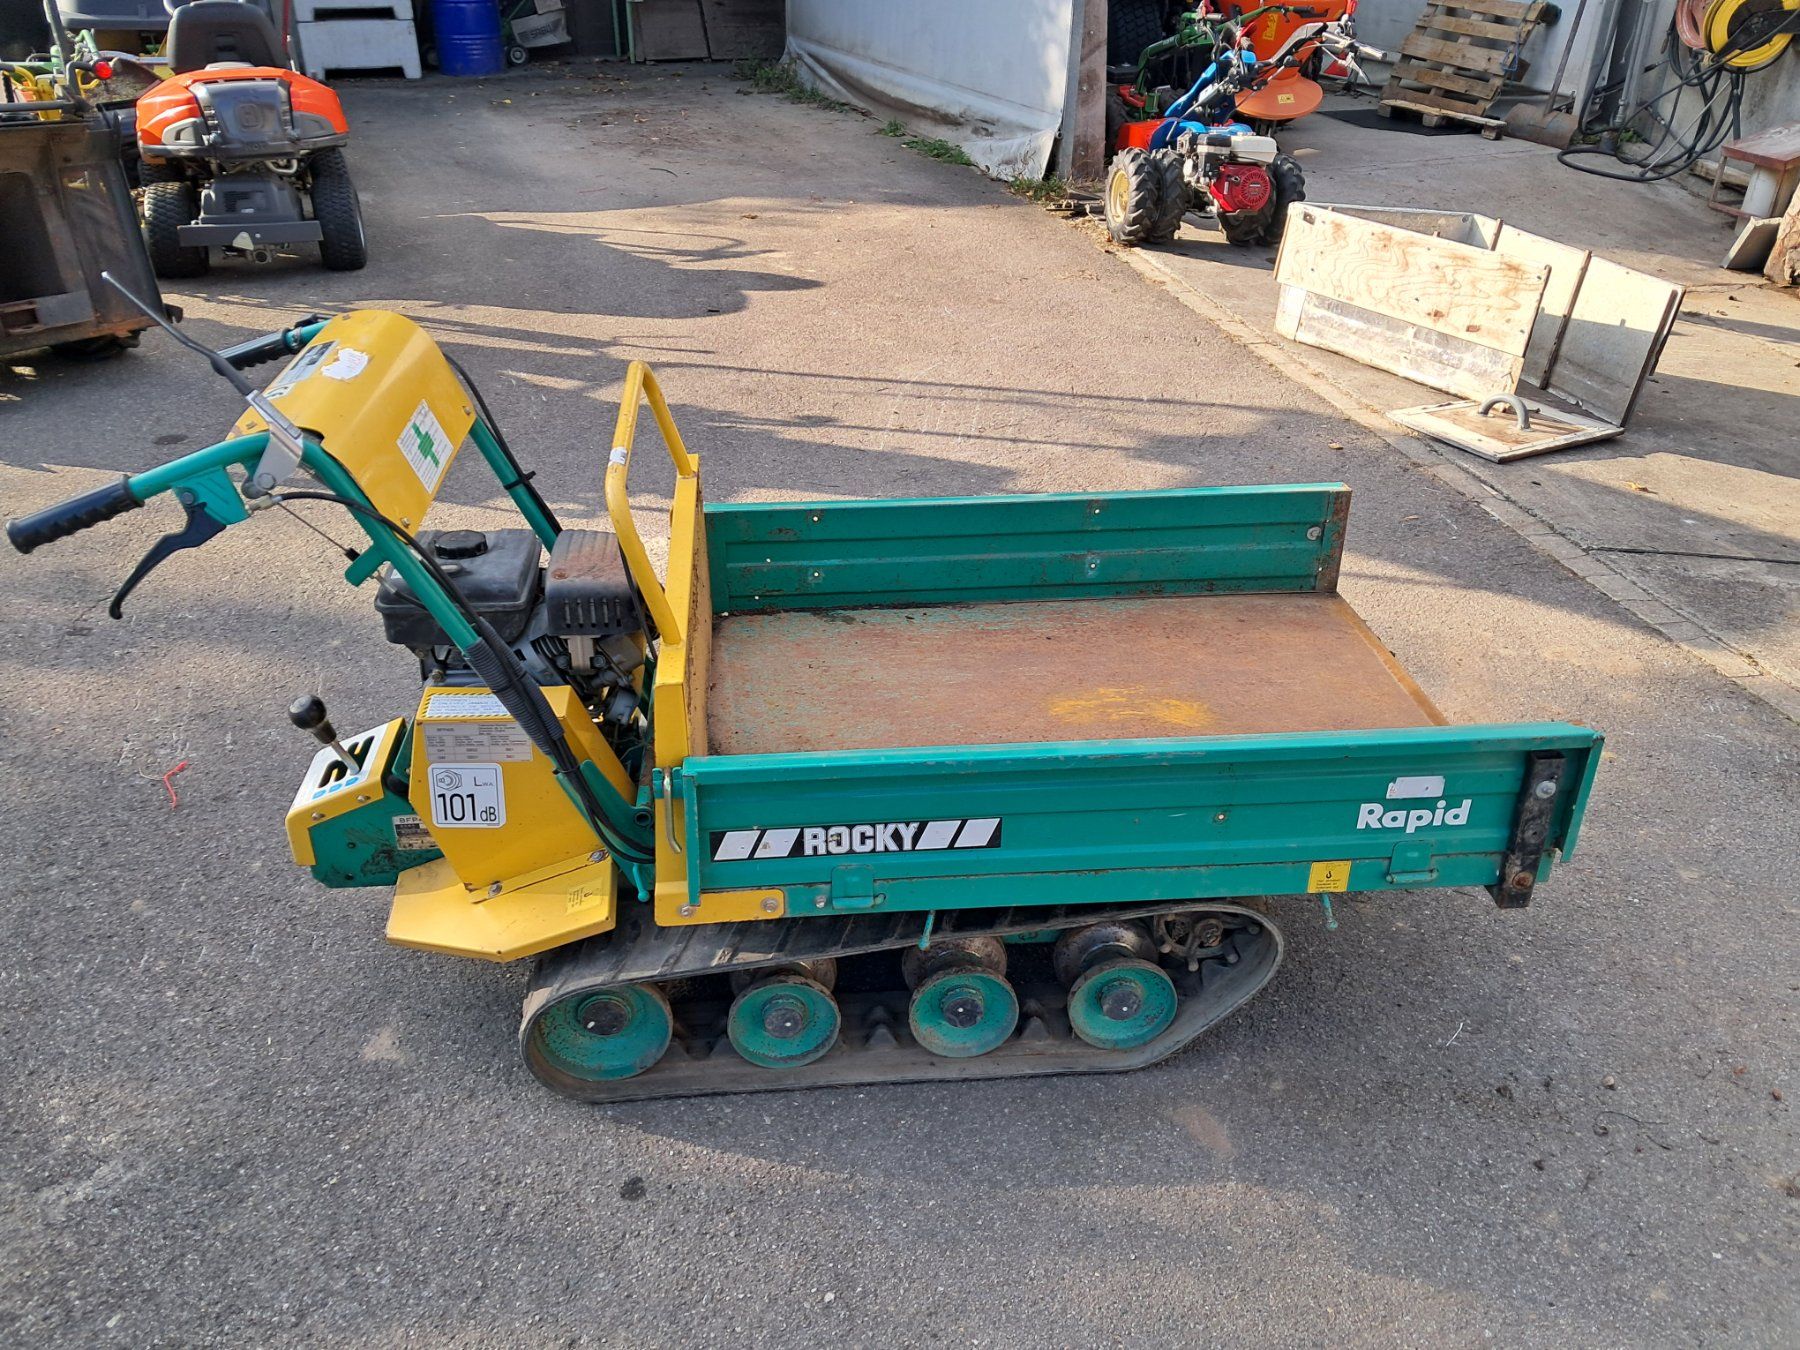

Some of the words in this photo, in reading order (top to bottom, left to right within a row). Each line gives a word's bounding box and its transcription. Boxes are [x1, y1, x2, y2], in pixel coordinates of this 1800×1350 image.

[437, 793, 476, 822] 101
[479, 806, 497, 822] dB
[1356, 798, 1472, 834] Rapid
[803, 821, 920, 856] ROCKY
